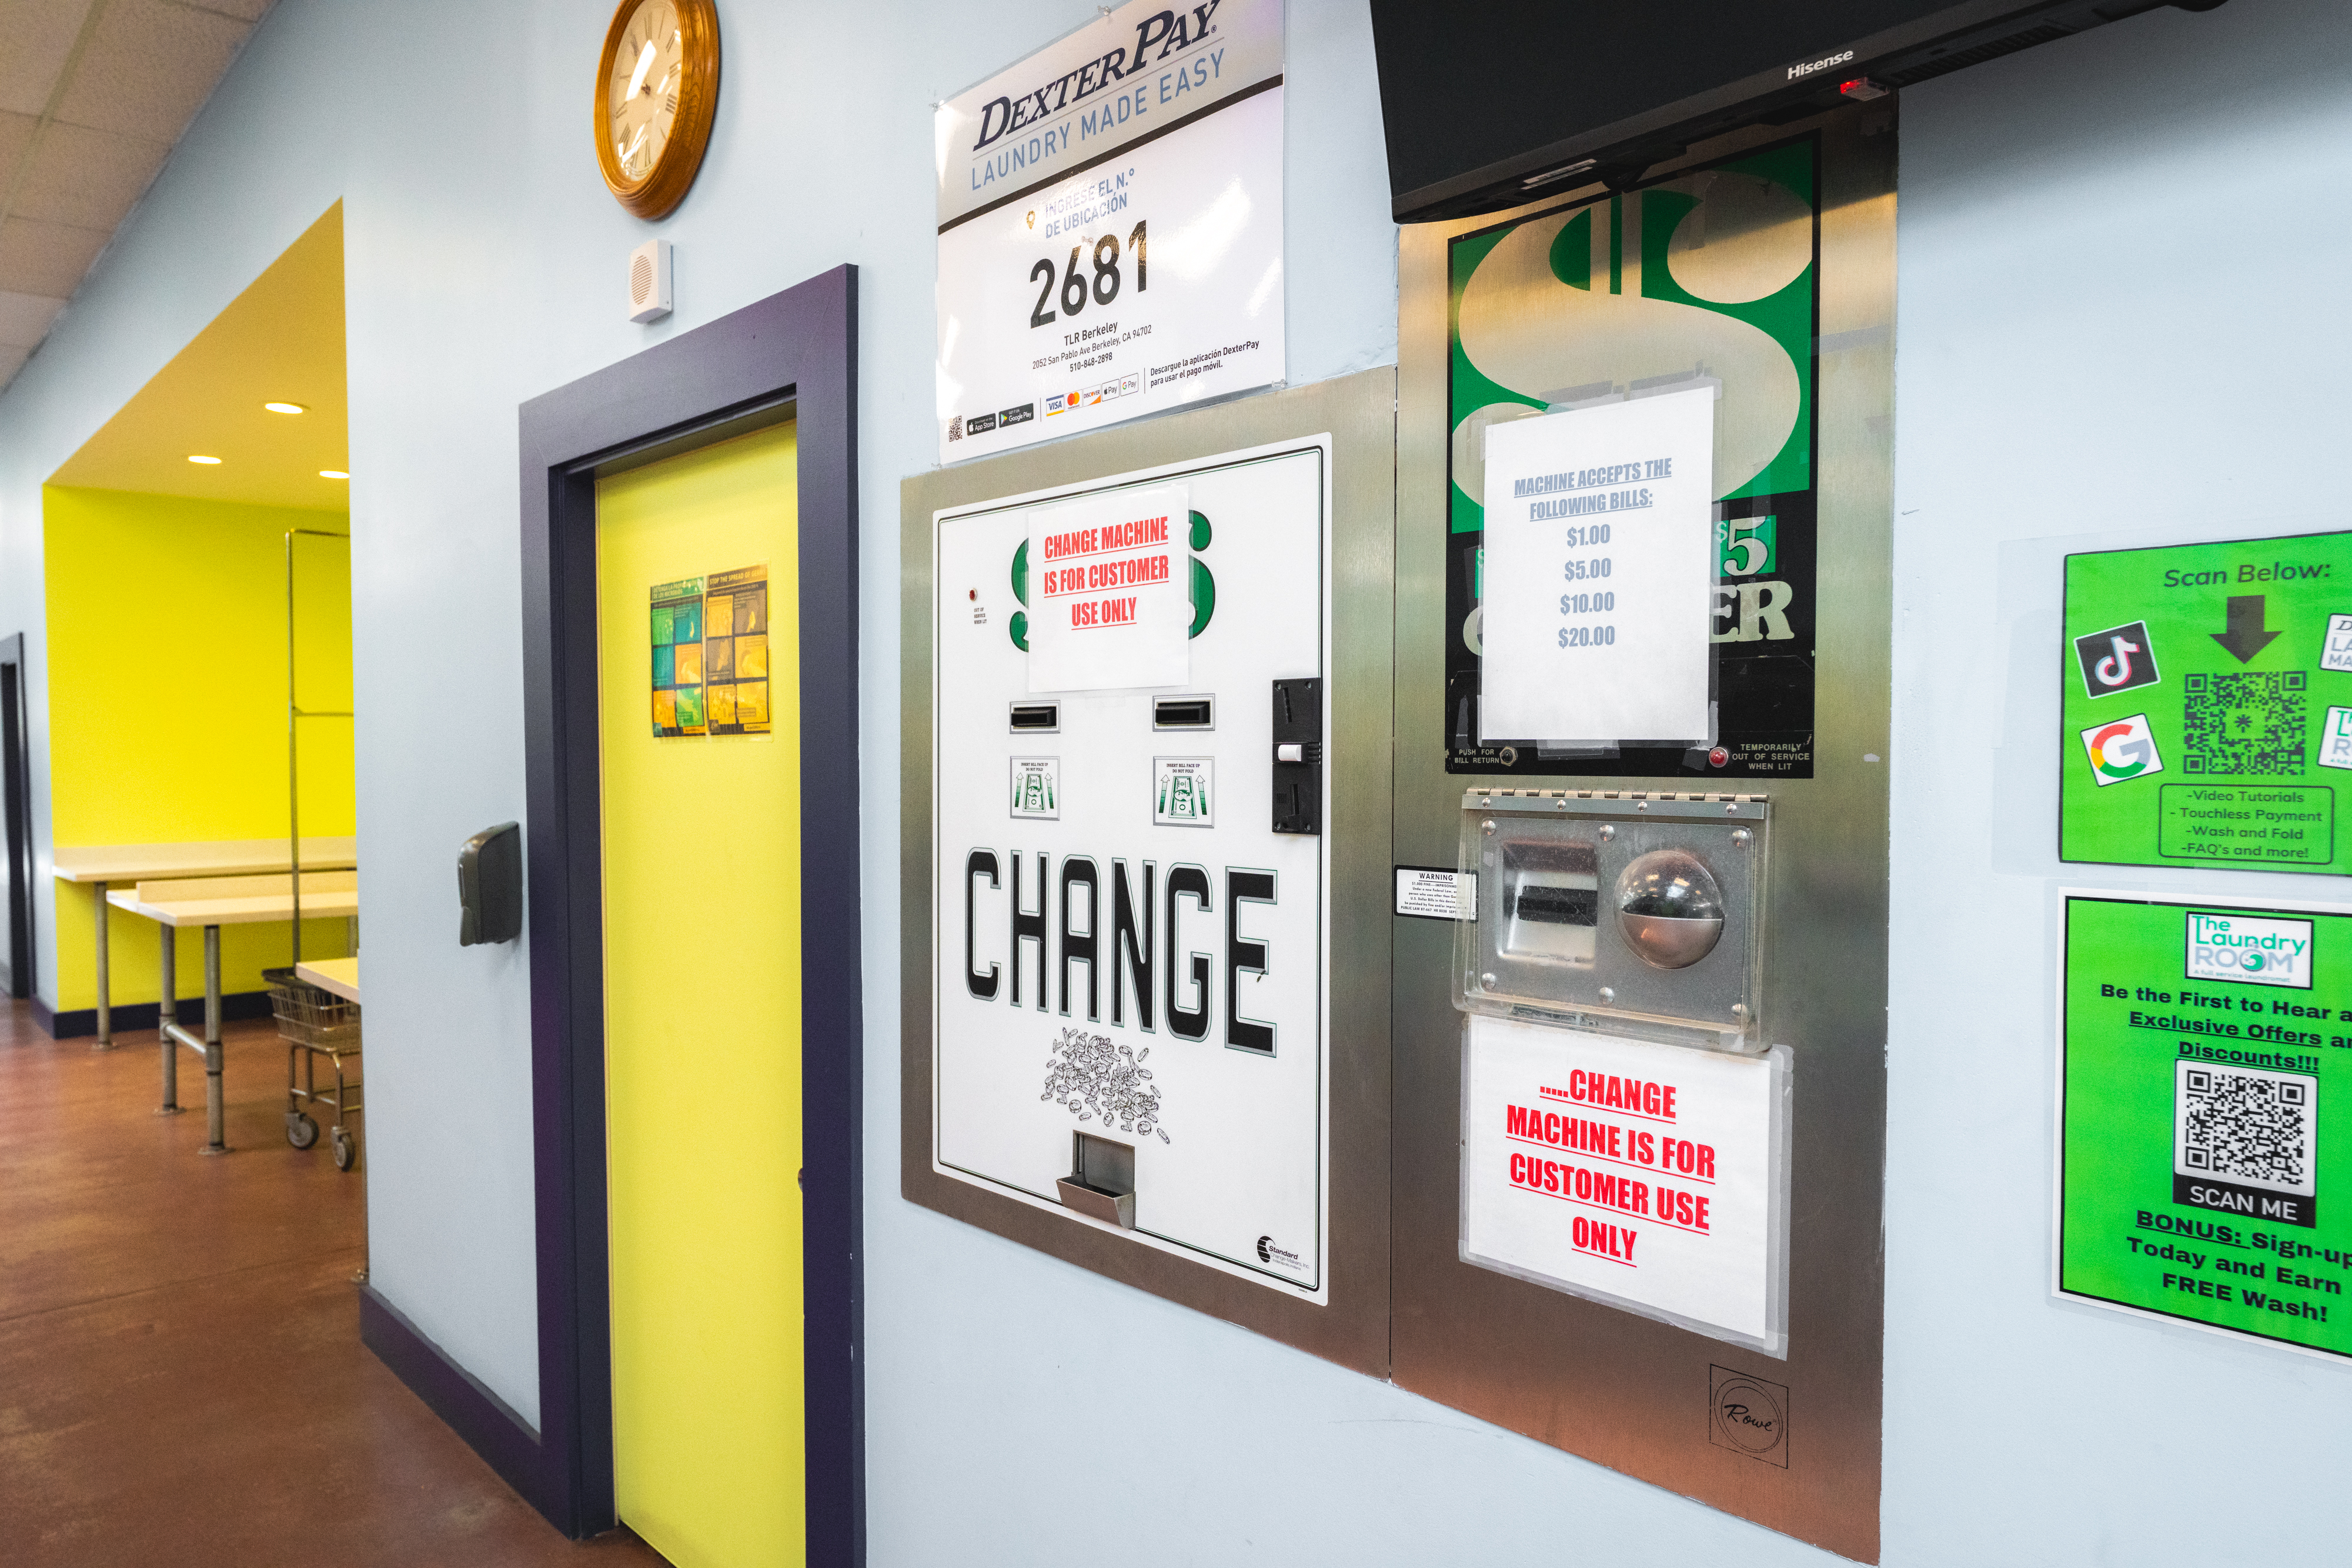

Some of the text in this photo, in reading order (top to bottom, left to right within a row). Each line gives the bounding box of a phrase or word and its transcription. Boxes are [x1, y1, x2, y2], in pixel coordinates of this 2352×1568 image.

[1788, 51, 1853, 79] Hisense
[972, 49, 1224, 190] LAUNDRY MADE EASY
[1045, 185, 1095, 218] INGRESE
[1098, 179, 1112, 196] EL
[1046, 192, 1127, 239] DE UBICACIÓN
[1030, 219, 1146, 329] 2681
[1033, 325, 1151, 369] 2052 San Pablo Ave Berkeley, CA 94702
[1064, 322, 1117, 346] TLR Berkeley
[1070, 352, 1112, 372] 510-848-2898
[1151, 361, 1181, 376] Descargue
[1190, 350, 1221, 366] aplicación
[1223, 341, 1259, 355] DexterPay
[1151, 377, 1163, 388] para
[1165, 373, 1178, 382] usar
[1187, 367, 1201, 378] pago
[1203, 360, 1223, 372] móvil.
[1048, 400, 1062, 410] VISA
[1514, 457, 1672, 497] MACHINE ACCEPTS THE
[1530, 488, 1652, 519] FOLLOWING BILLS:
[1044, 516, 1168, 559] CHANGE MACHINE
[1567, 524, 1611, 548] $1.00
[1044, 555, 1169, 594] IS FOR CUSTOMER
[1565, 558, 1612, 582] $5.00
[2164, 561, 2330, 587] Scan Below:
[1071, 597, 1137, 627] USE ONLY
[1560, 592, 1615, 615] $10.00
[1558, 626, 1615, 649] $20.00
[1740, 744, 1801, 752] TEMPORARILY
[2239, 791, 2304, 803] Tutorials
[2180, 808, 2322, 823] Touchless Payment
[2239, 828, 2267, 838] and
[2272, 828, 2303, 839] Fold
[2234, 846, 2261, 855] and
[2267, 848, 2308, 857] more!
[2192, 915, 2230, 931] The
[965, 847, 1277, 1058] CHANGE
[2195, 946, 2293, 972] ROOM
[2196, 933, 2306, 955] Laundry
[2101, 984, 2331, 1019] Be the First to Hear
[2129, 1011, 2239, 1035] Exclusive
[2248, 1024, 2321, 1045] Offers
[2179, 1041, 2319, 1071] Discounts!!!
[1507, 1104, 1715, 1179] MACHINE IS FOR
[1510, 1153, 1709, 1230] CUSTOMER USE
[2190, 1186, 2297, 1221] SCAN ME
[1269, 1245, 1298, 1259] Standard
[1572, 1216, 1637, 1261] ONLY
[2137, 1210, 2352, 1269] BONUS: Sign-up
[2127, 1236, 2341, 1295] Today and Earn
[2163, 1273, 2327, 1322] FREE Wash!
[1724, 1405, 1772, 1431] Rowe
